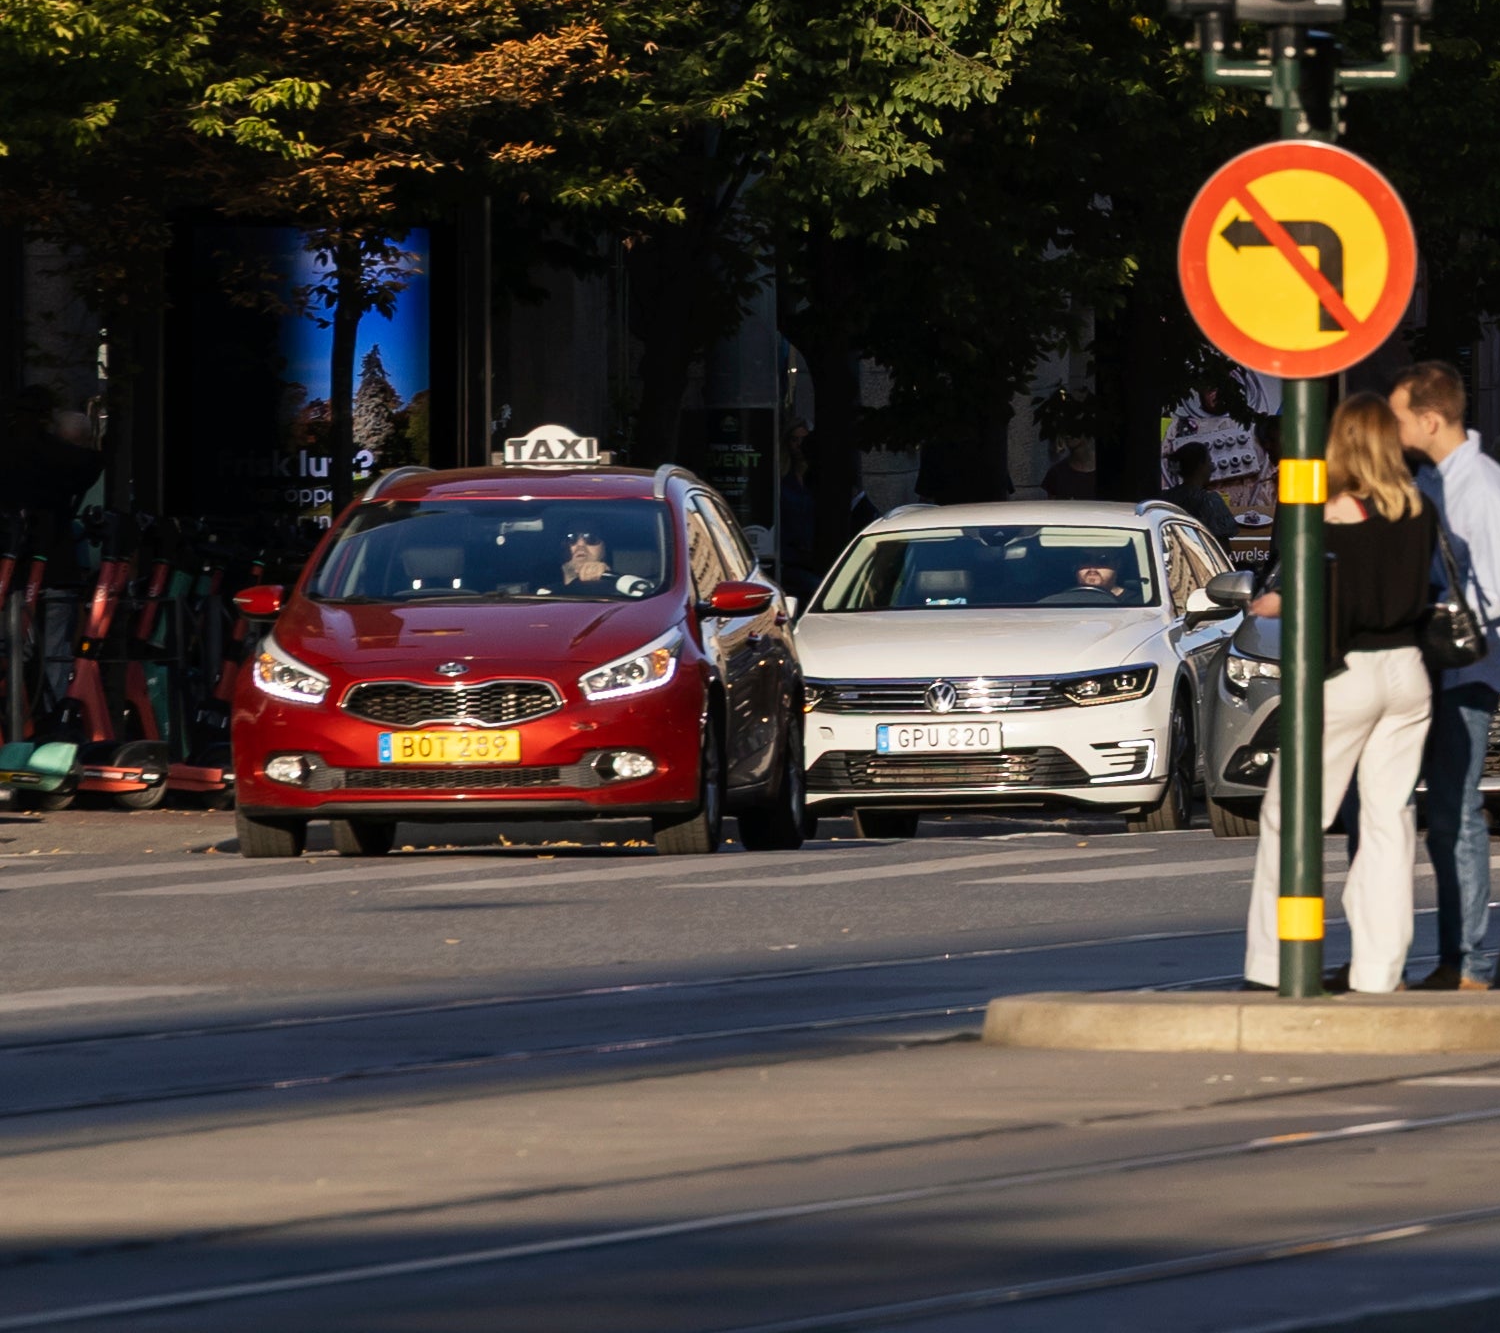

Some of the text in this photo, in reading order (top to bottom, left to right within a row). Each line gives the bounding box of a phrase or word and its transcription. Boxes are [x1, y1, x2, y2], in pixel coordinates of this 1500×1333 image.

[506, 438, 594, 460] TAXI
[299, 449, 375, 478] lu?
[458, 735, 507, 757] 289
[898, 727, 990, 748] GPU 820
